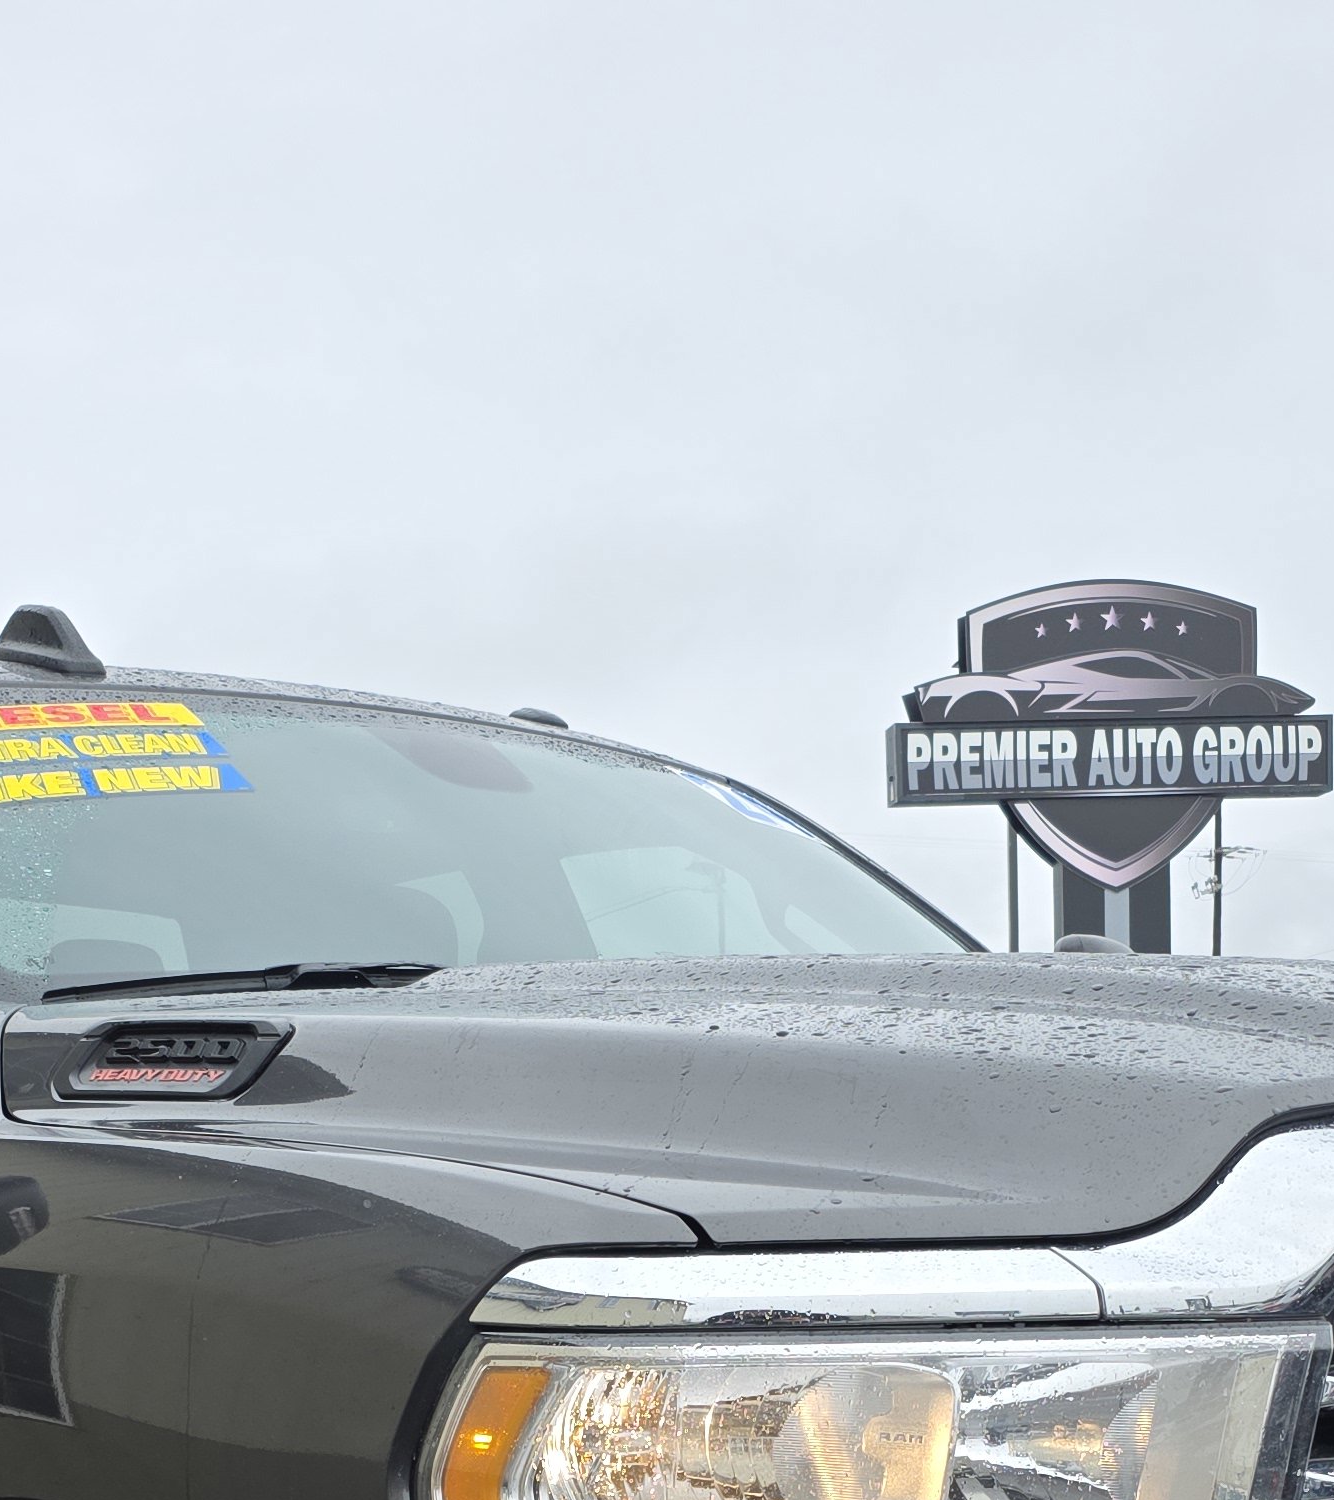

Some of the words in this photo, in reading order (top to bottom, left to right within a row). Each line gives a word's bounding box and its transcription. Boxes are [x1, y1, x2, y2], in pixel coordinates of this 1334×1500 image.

[73, 733, 207, 757] CLEAN
[907, 730, 1078, 790] PREMIER
[1088, 726, 1183, 787] AUTO
[1192, 725, 1323, 784] GROUP
[93, 765, 220, 793] NEW
[105, 1037, 246, 1064] 2500
[89, 1067, 161, 1082] HEAVY
[163, 1067, 227, 1082] DUTY
[879, 1432, 924, 1444] RAM
